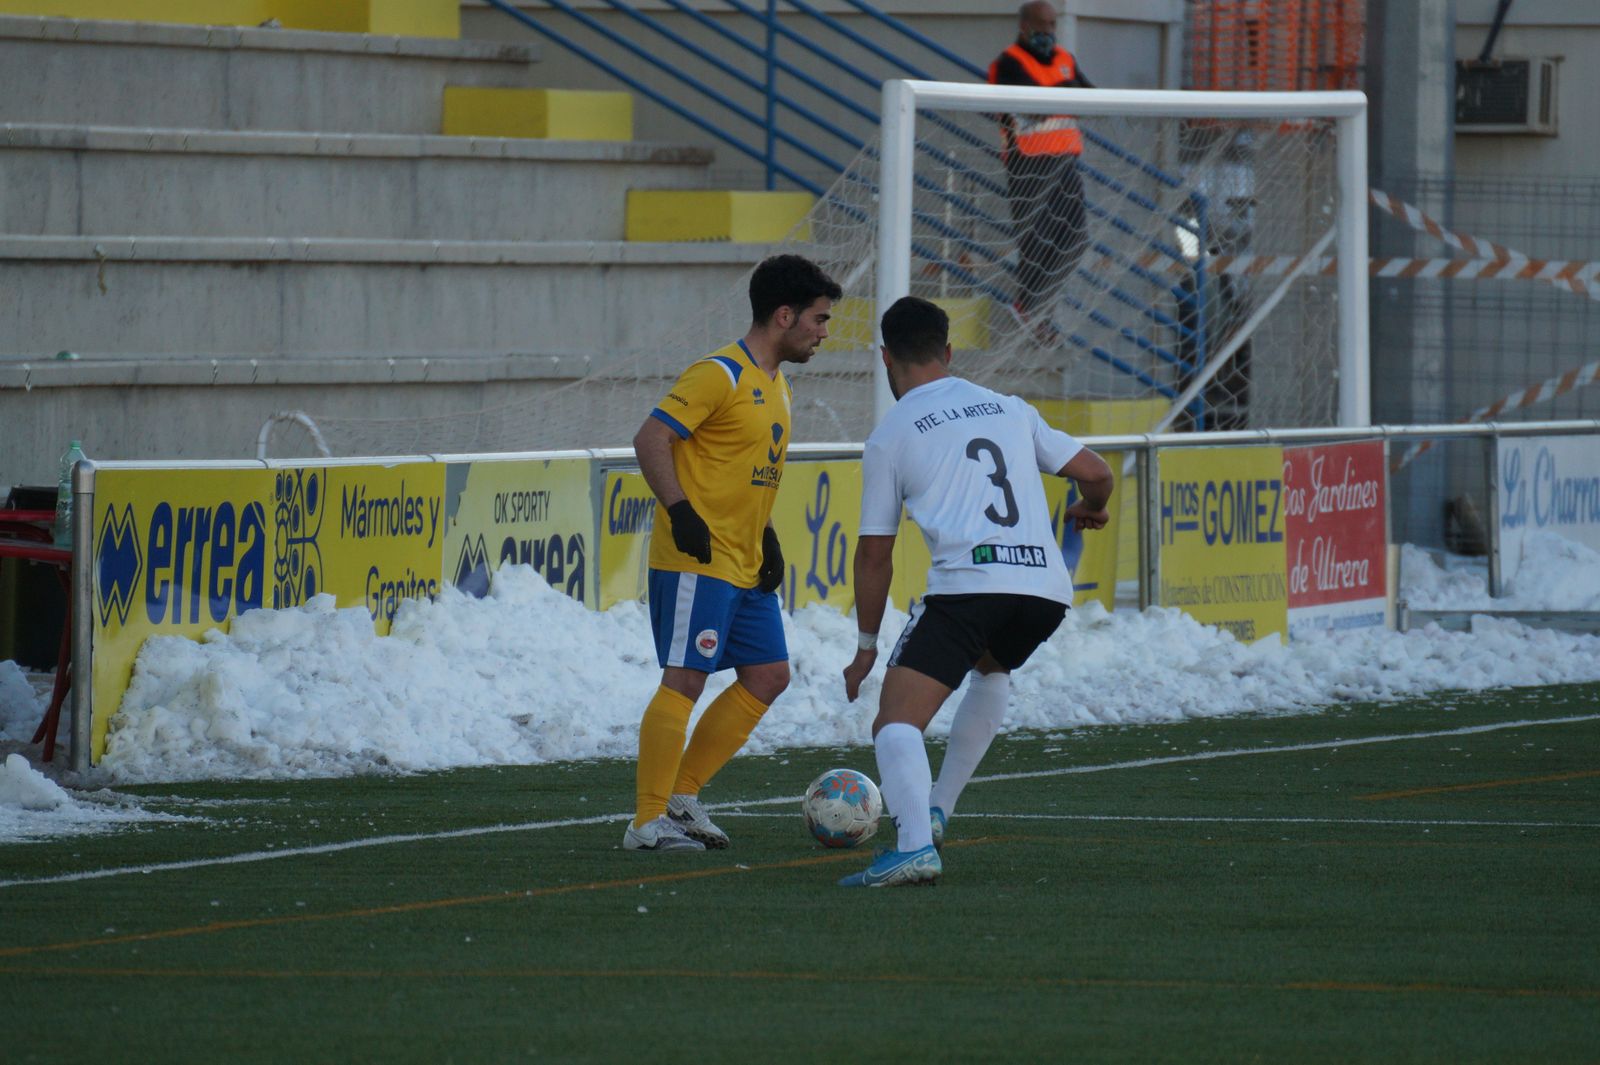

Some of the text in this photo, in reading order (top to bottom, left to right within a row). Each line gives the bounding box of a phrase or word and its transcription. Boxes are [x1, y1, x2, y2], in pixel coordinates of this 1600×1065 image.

[914, 402, 1006, 434] RTE. LA ARTESA
[494, 490, 551, 524] OK SPORTY
[966, 437, 1020, 528] 3
[1202, 479, 1283, 546] GOMEZ
[1308, 454, 1378, 523] Jardines
[341, 480, 440, 549] Mármoles y
[995, 545, 1046, 566] MILAR
[1291, 535, 1369, 594] de Utrera
